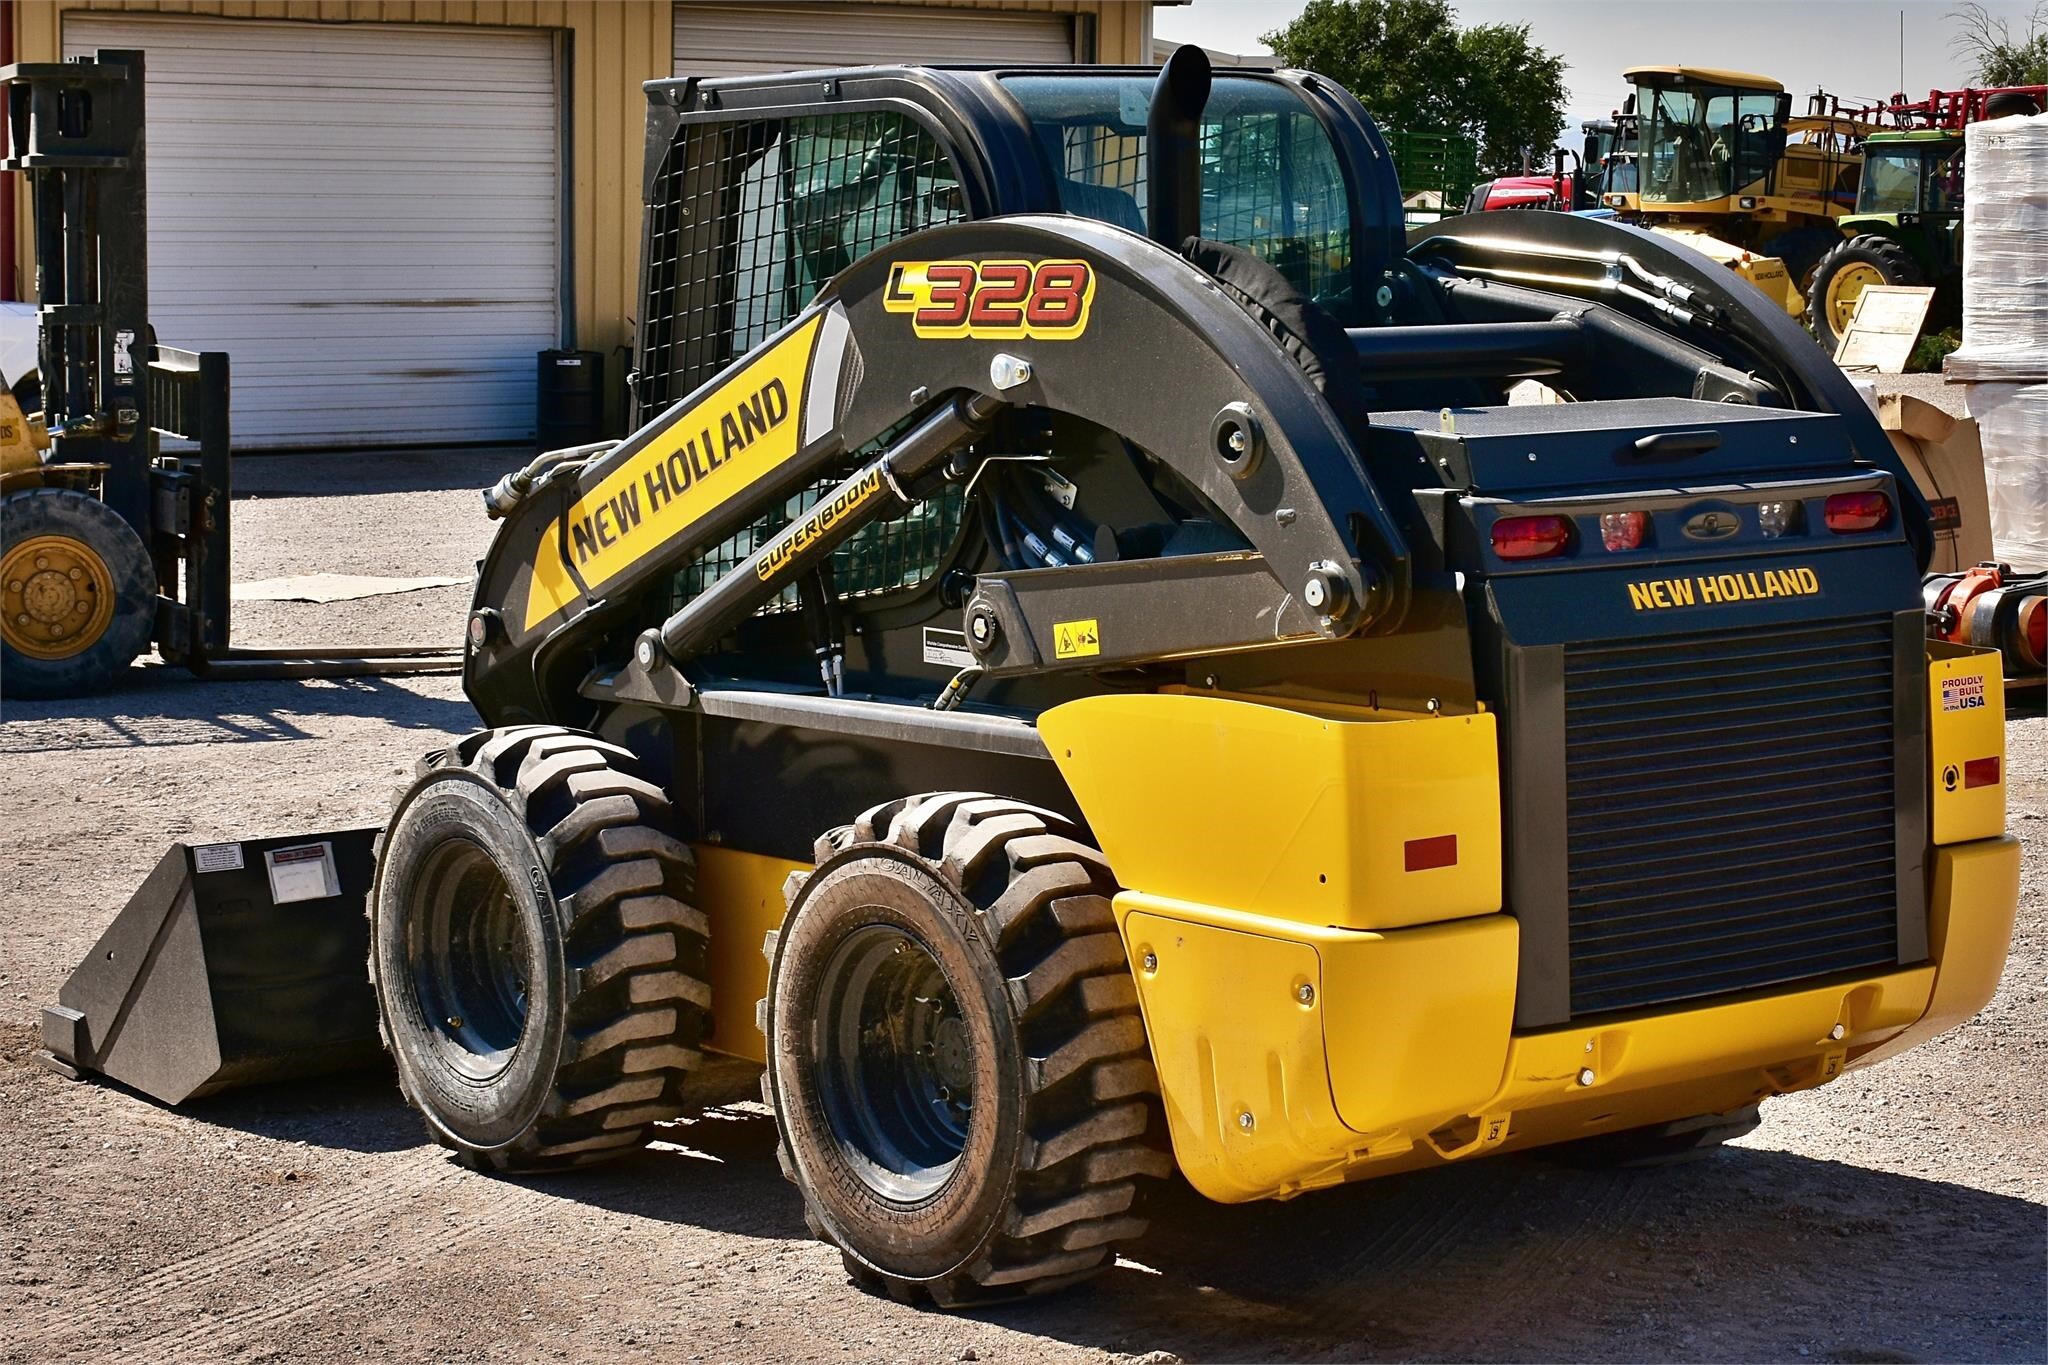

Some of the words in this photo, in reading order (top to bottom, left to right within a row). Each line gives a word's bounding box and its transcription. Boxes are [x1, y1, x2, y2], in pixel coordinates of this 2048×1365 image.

[572, 481, 642, 565] NEW
[643, 377, 790, 514] HOLLAND
[1628, 578, 1696, 610] NEW
[1697, 568, 1819, 604] HOLLAND
[1942, 675, 1983, 688] PROUDLY
[1959, 685, 1984, 696] BUILT
[1960, 696, 1985, 709] USA
